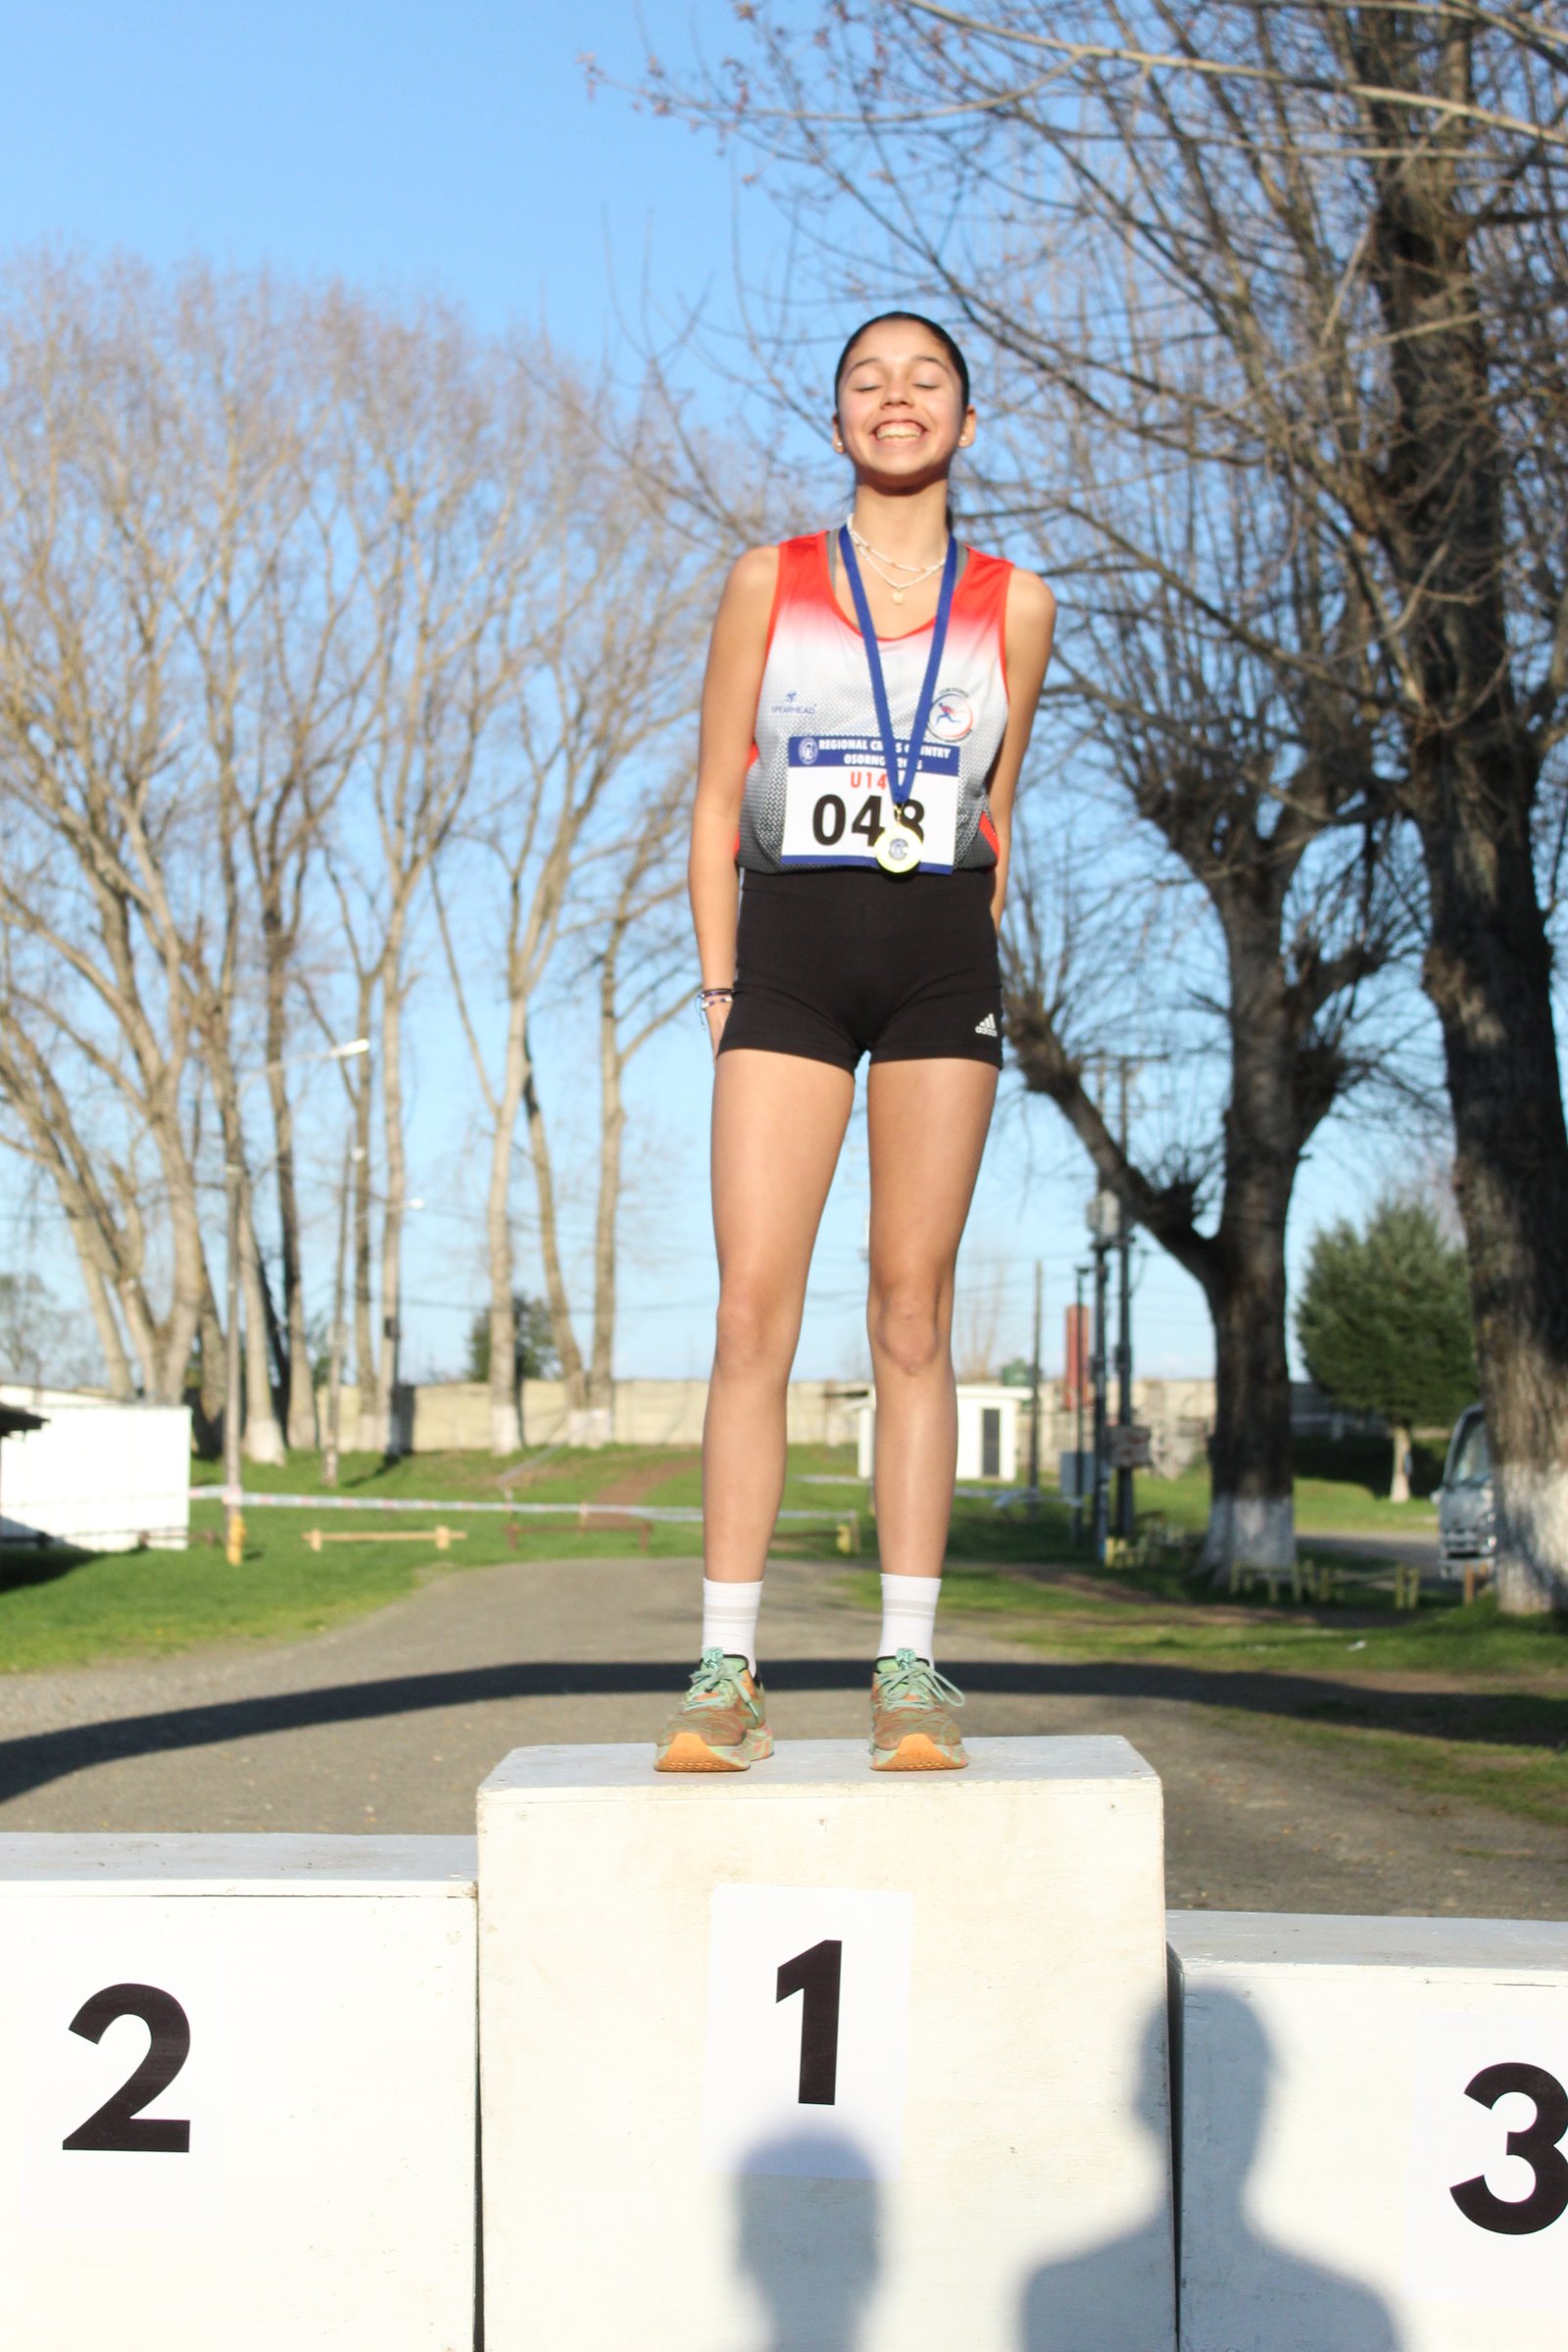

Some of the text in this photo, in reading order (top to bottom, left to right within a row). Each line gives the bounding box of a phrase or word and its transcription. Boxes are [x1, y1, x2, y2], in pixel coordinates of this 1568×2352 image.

[818, 739, 951, 759] REGIONAL CRS CNTRY
[844, 754, 886, 766] OSORNO
[812, 794, 924, 847] 048
[63, 1984, 190, 2152] 2
[776, 1940, 842, 2105] 1
[1449, 2063, 1568, 2234] 3
